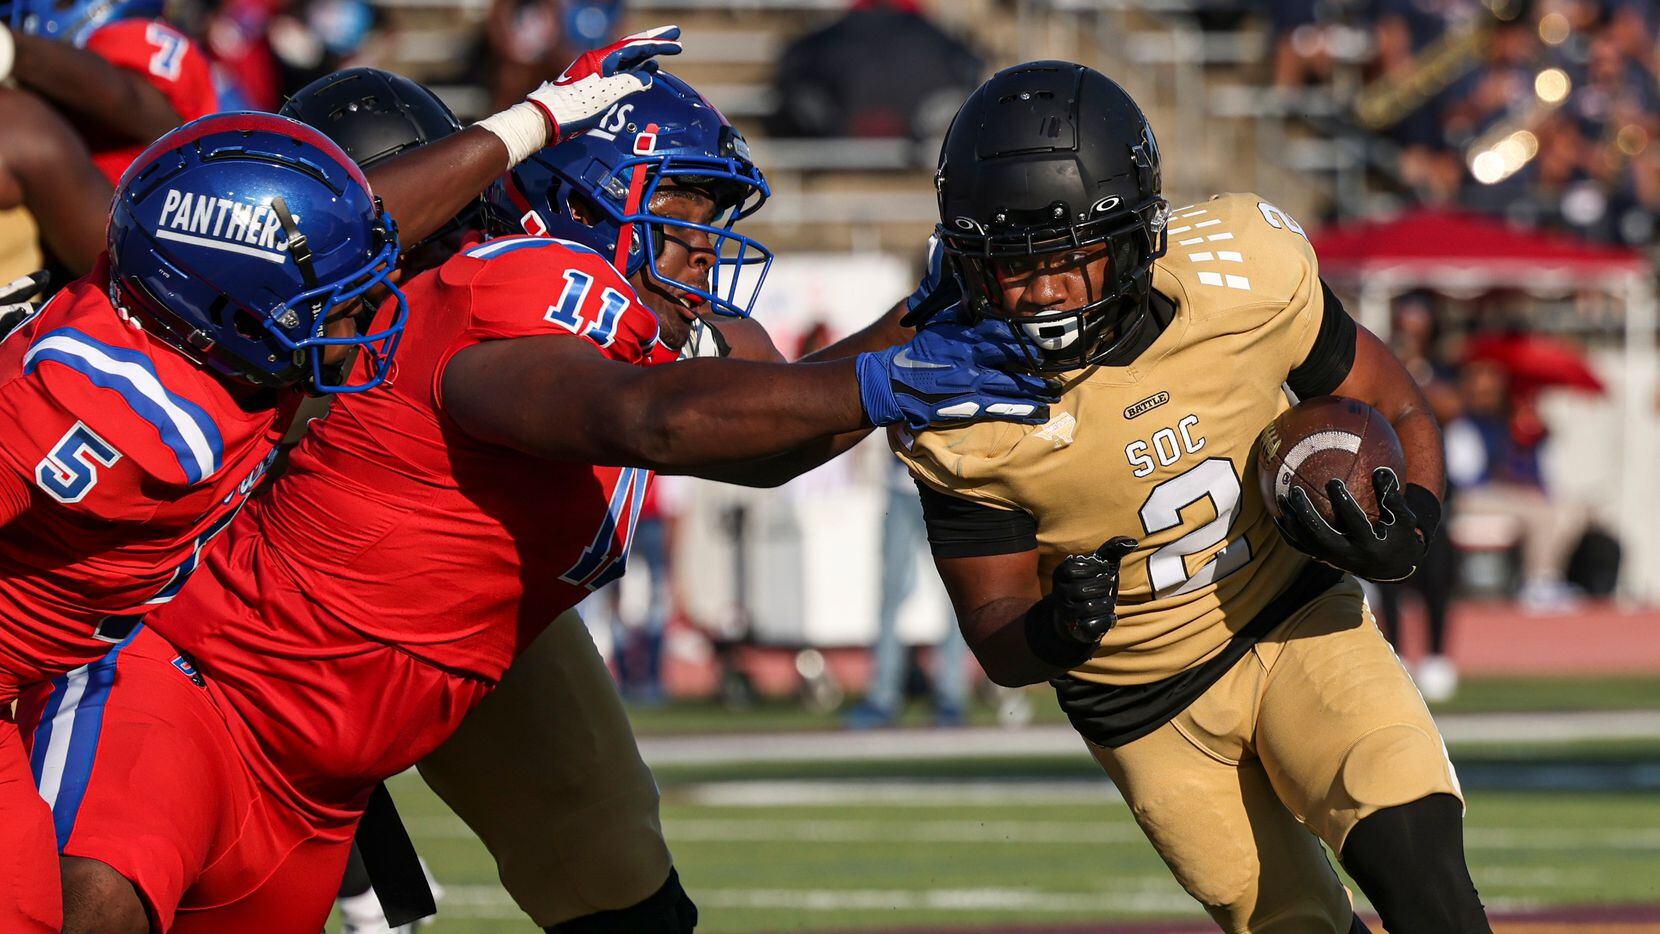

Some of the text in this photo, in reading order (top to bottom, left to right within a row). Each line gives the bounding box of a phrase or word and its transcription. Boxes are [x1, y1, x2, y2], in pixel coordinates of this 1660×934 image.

[145, 21, 189, 82] 7
[543, 268, 631, 349] 11
[1127, 393, 1167, 417] BATTLE
[34, 419, 124, 504] 5
[1124, 413, 1206, 478] SOC
[1137, 456, 1255, 601] 2
